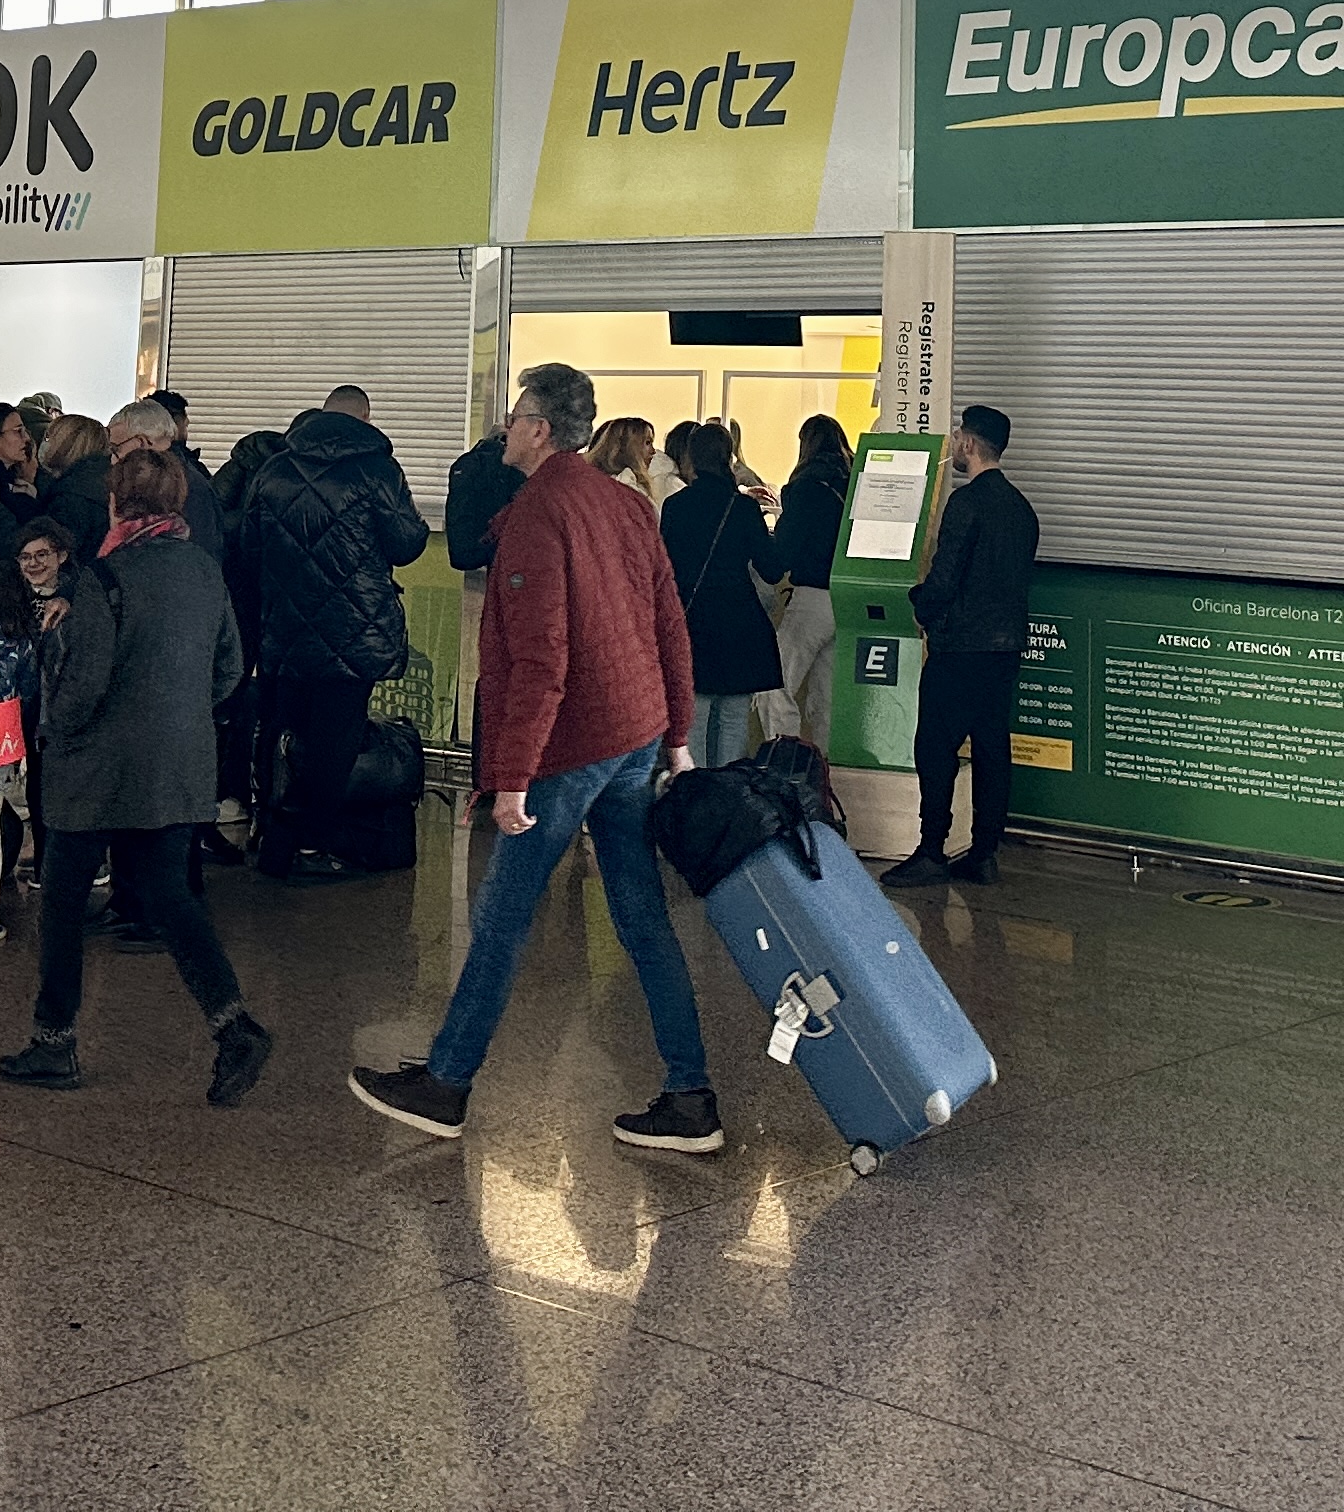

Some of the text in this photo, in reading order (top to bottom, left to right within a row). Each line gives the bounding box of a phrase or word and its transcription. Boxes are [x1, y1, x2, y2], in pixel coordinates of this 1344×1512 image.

[586, 50, 796, 138] Hertz
[191, 81, 457, 157] GOLDCAR
[895, 320, 913, 433] Register her
[916, 401, 931, 434] aqu
[1192, 597, 1344, 625] Oficina Barcelona T2
[1028, 622, 1059, 636] TURA
[865, 645, 889, 671] E
[1157, 633, 1212, 650] ATENCIÓ
[1226, 640, 1292, 658] ATENCIÓN
